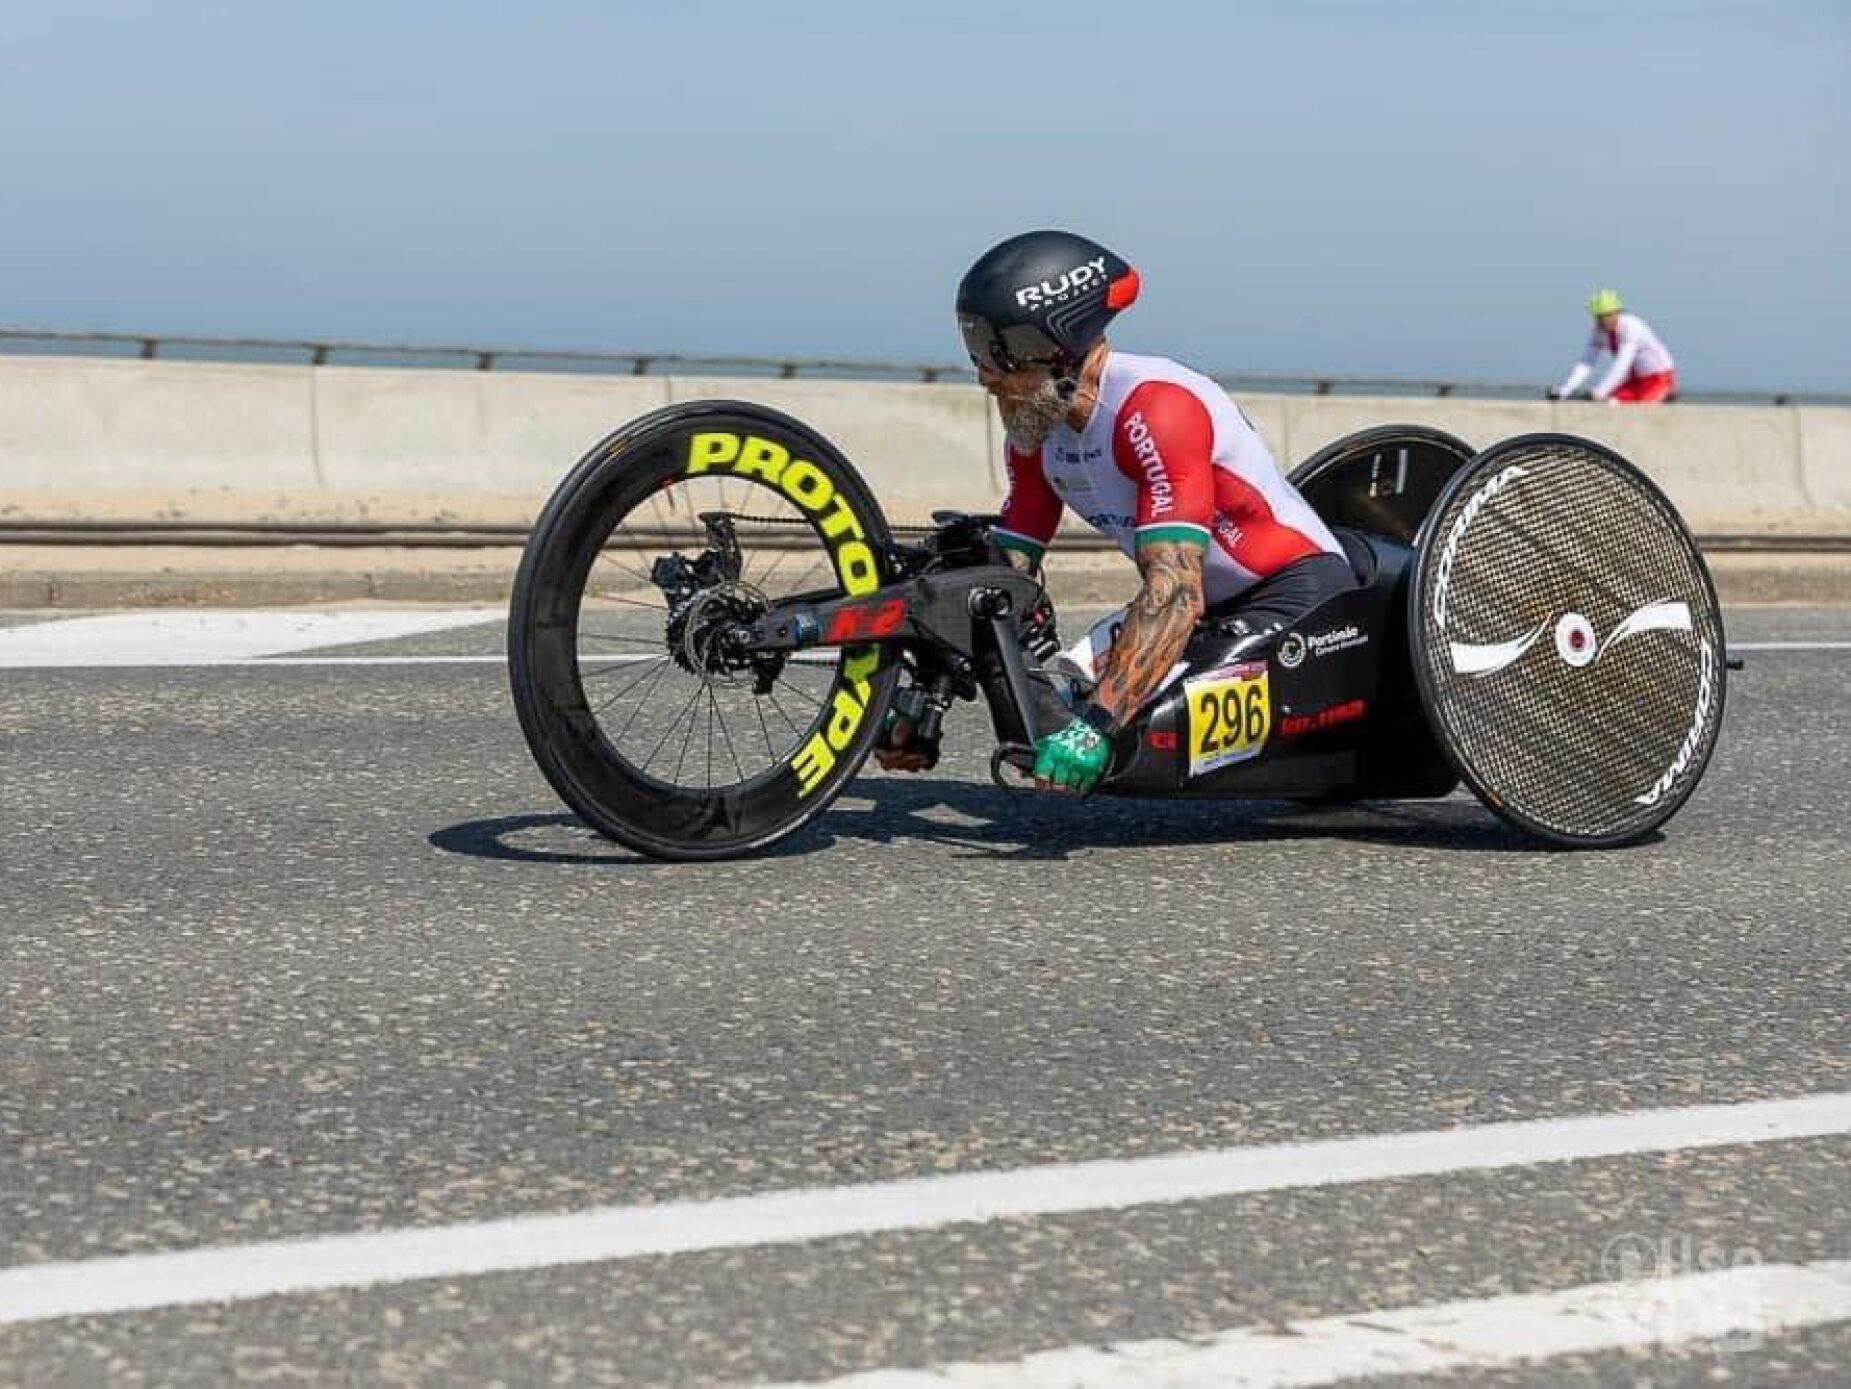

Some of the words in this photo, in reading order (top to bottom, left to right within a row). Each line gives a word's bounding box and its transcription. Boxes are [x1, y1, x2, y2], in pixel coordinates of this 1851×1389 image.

[1016, 256, 1104, 306] RUDY
[1123, 411, 1173, 517] PORTUGAL
[686, 432, 881, 799] PROTOYPE
[1199, 684, 1265, 754] 296
